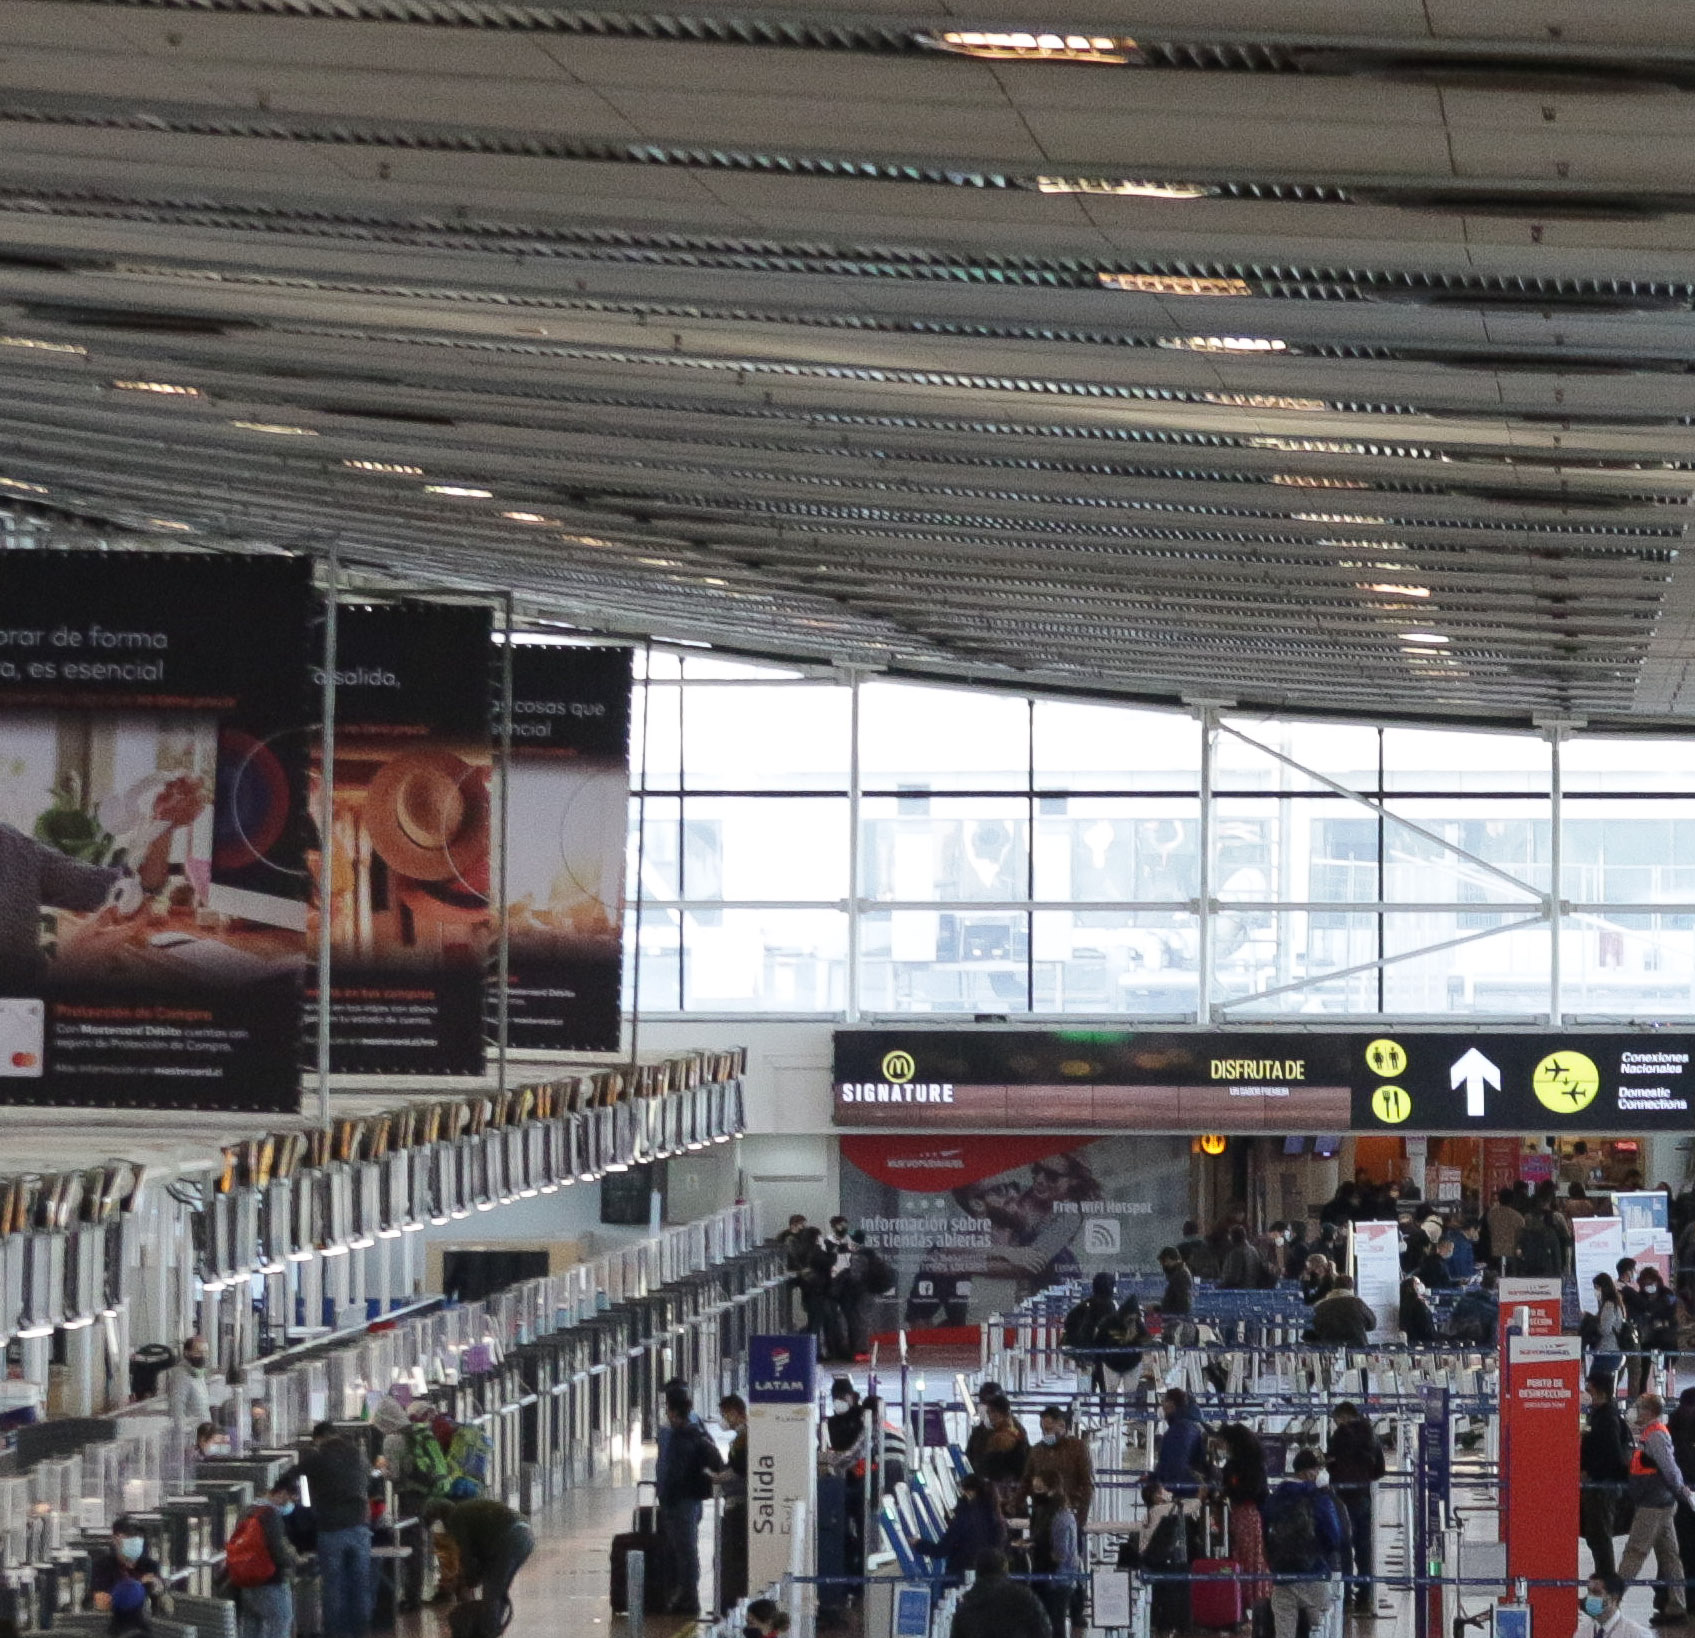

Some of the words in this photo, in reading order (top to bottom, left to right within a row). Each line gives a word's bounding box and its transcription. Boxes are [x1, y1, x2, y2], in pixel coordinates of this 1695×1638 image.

[50, 626, 83, 648] de
[88, 624, 168, 649] forma
[28, 660, 57, 679] es
[63, 659, 165, 681] esencial
[333, 669, 401, 688] salida,
[514, 701, 566, 715] cosas
[570, 702, 606, 718] que
[1621, 1051, 1690, 1063] Conexiones
[1210, 1059, 1283, 1080] DISFRUTA
[1285, 1059, 1306, 1080] DE
[1620, 1063, 1683, 1074] Nacionales
[842, 1082, 954, 1103] SIGNATURE
[1618, 1086, 1671, 1098] Domestic
[1617, 1098, 1688, 1110] Connections
[1052, 1201, 1079, 1214] Free
[1106, 1201, 1153, 1215] Hotspot
[860, 1214, 949, 1232] Información
[950, 1215, 992, 1232] sobre
[864, 1235, 880, 1248] as
[883, 1232, 933, 1249] tiendas
[935, 1232, 992, 1249] abiertas
[754, 1380, 804, 1391] LATAM
[753, 1455, 775, 1535] Salida
